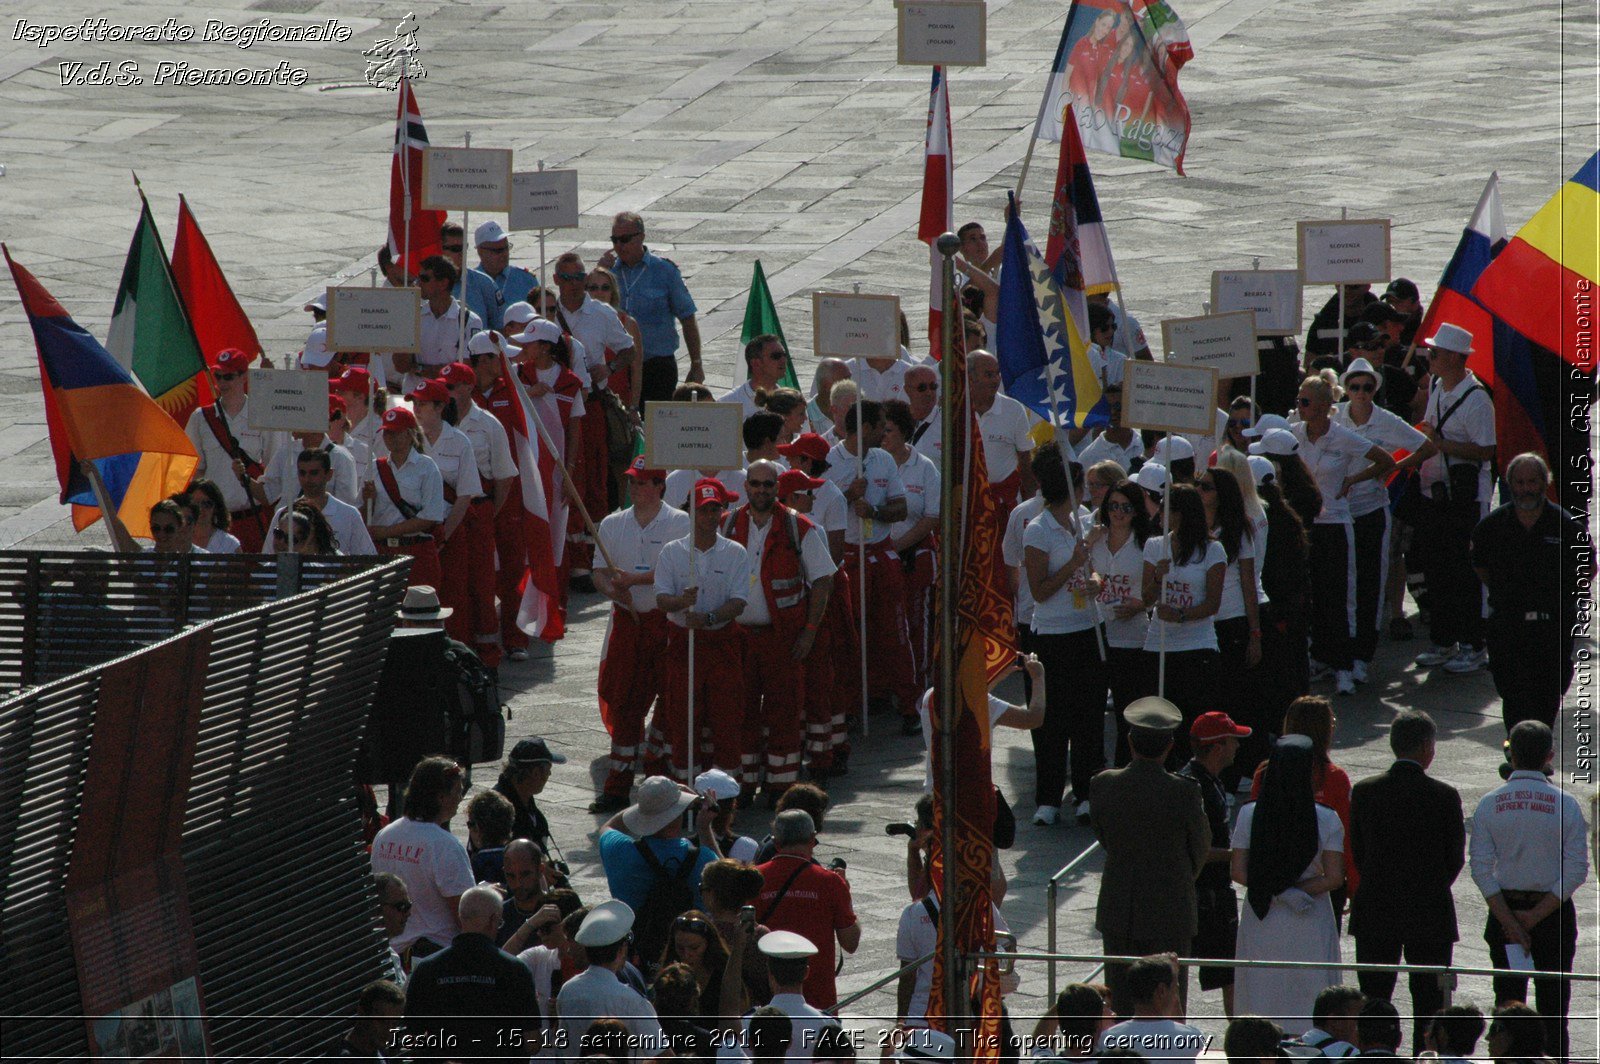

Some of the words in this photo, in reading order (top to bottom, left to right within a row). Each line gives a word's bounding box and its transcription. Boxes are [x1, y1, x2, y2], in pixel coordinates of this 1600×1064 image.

[926, 38, 956, 46] (POLAND)
[1327, 258, 1363, 266] (SLOVENIA)
[845, 332, 869, 340] (ITALY)
[1192, 335, 1232, 346] MACEDONIA
[1191, 351, 1236, 362] (MACEDONIA)
[271, 404, 306, 412] (ARMENIA)
[678, 443, 712, 451] (AUSTRIA)
[1514, 790, 1533, 800] ROSSA
[1530, 802, 1556, 815] MANAGER
